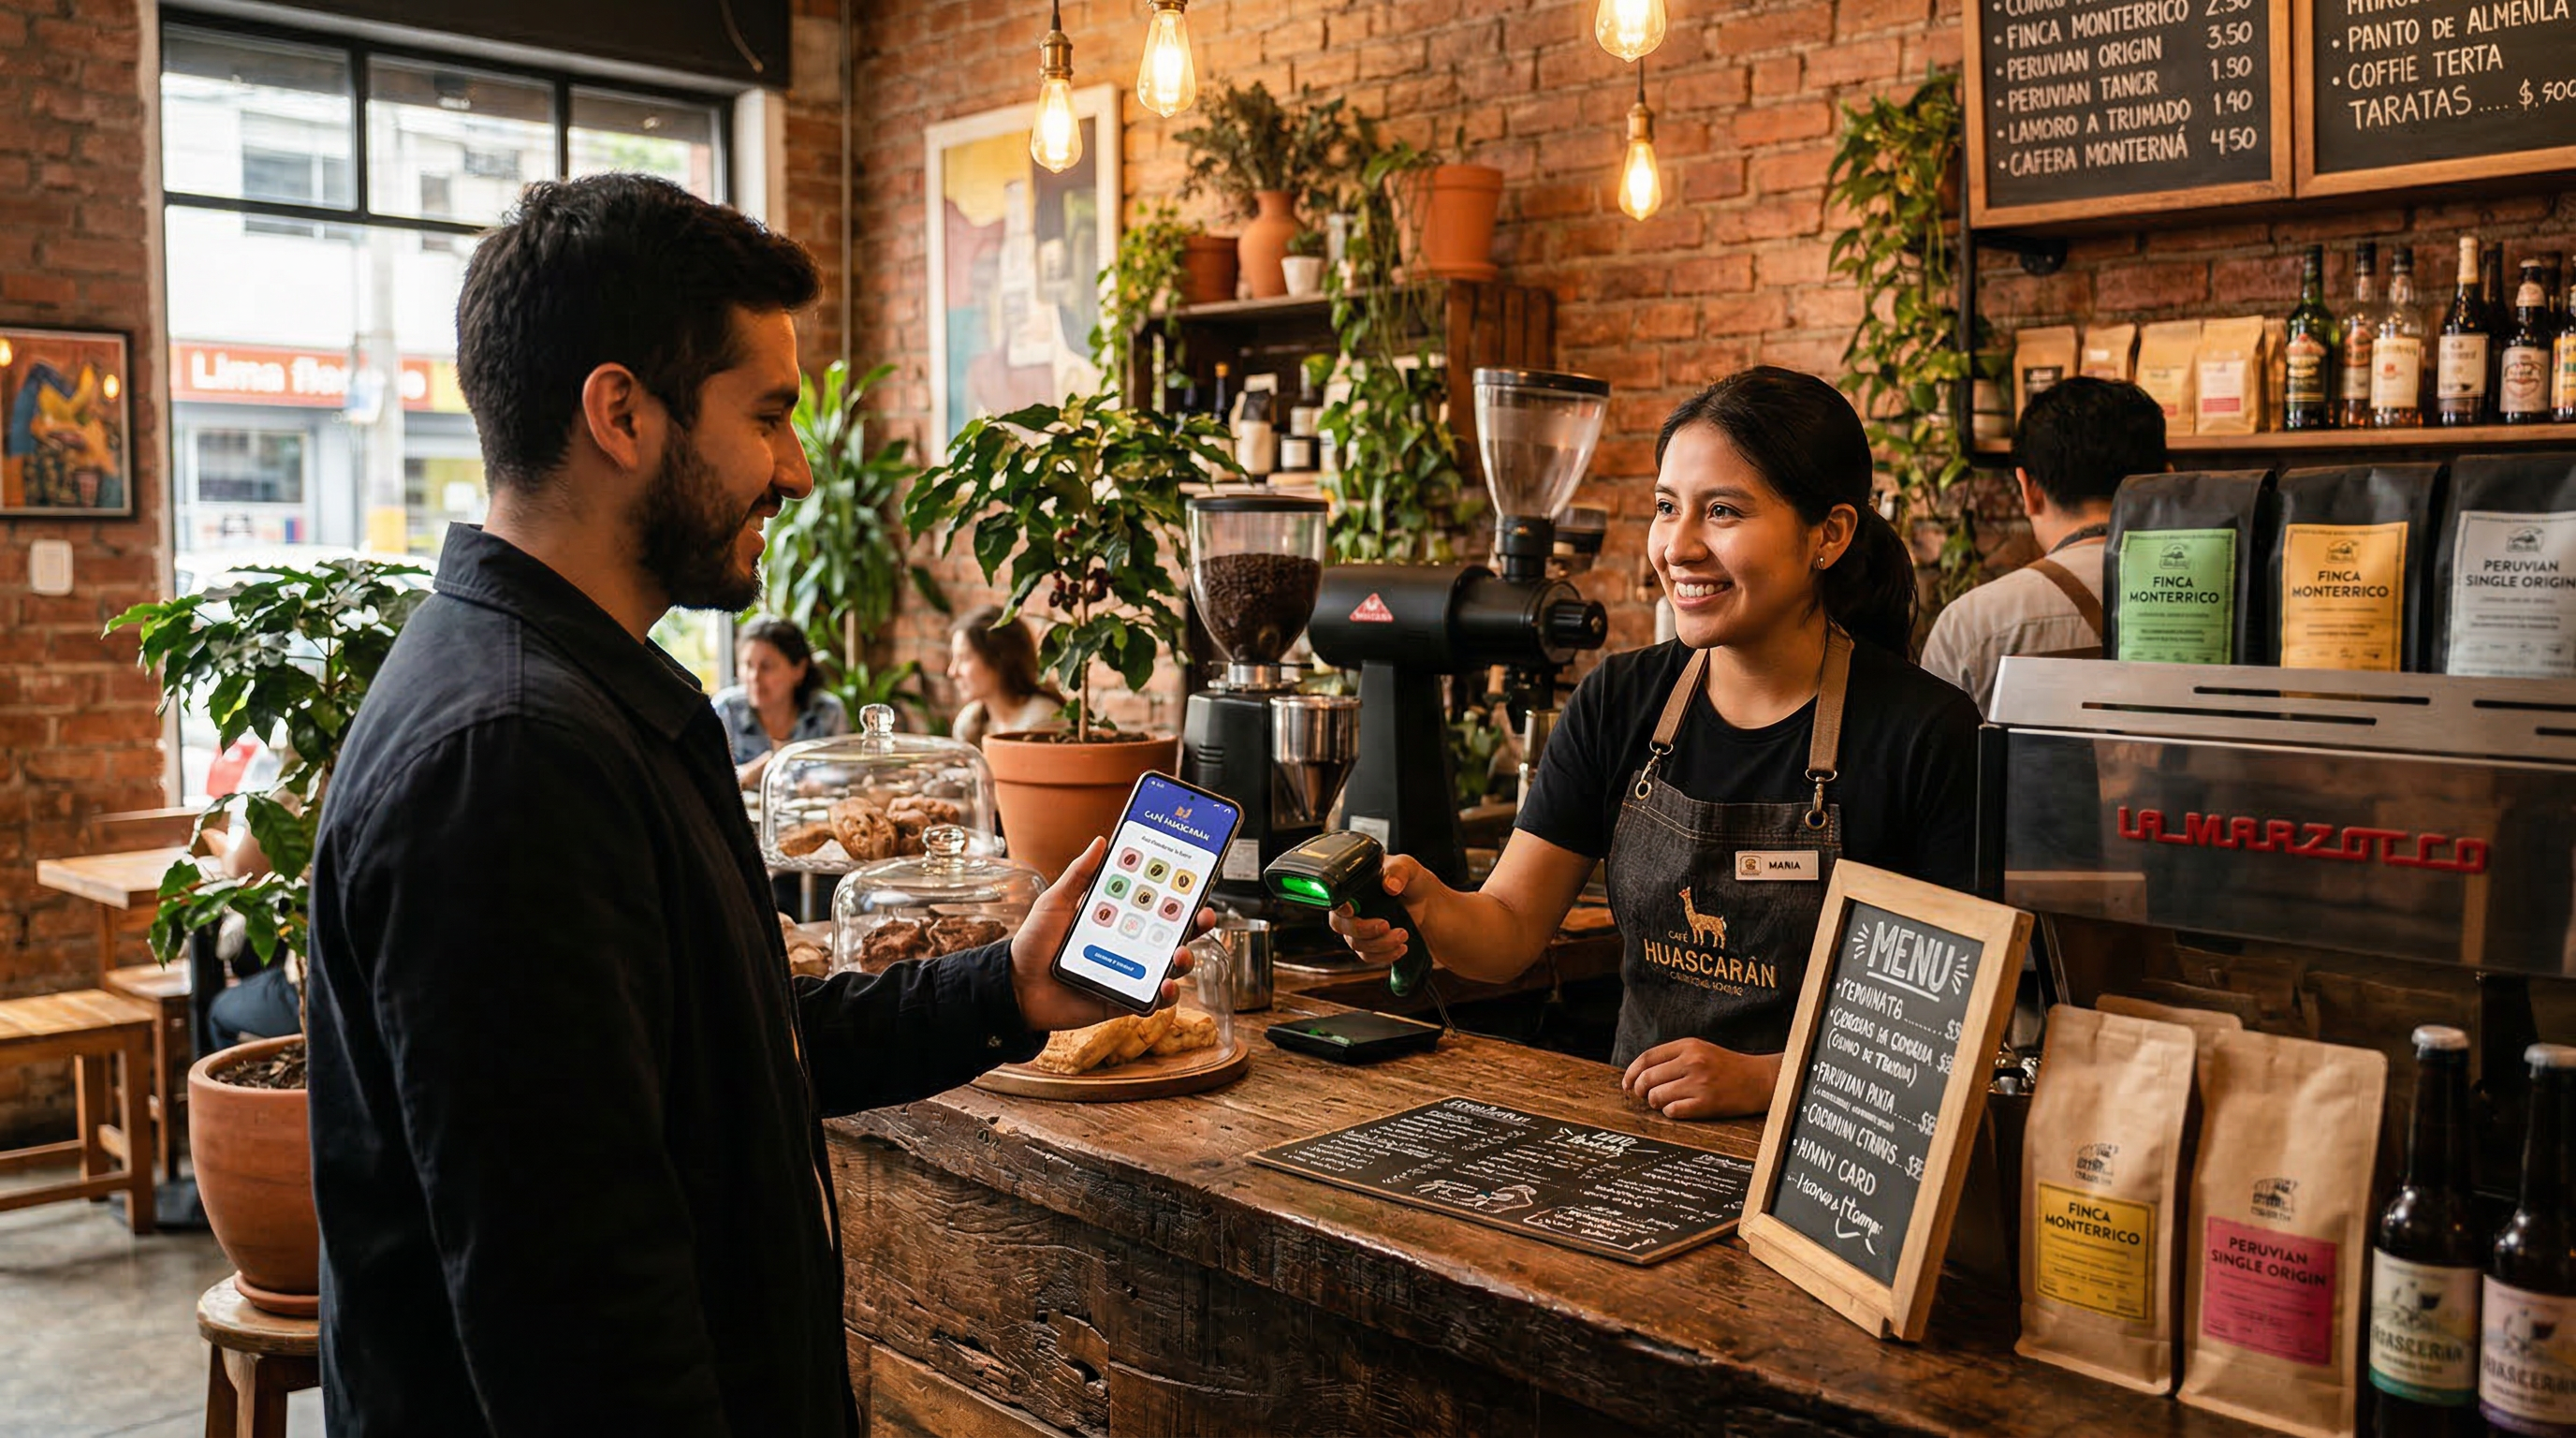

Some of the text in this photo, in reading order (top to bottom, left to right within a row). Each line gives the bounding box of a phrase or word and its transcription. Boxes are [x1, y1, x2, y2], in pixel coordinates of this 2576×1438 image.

[2007, 19, 2062, 51] FINCA
[2071, 0, 2189, 39] MONTERRICO
[2206, 21, 2253, 50] 3.50
[2348, 19, 2421, 52] PANTO
[2432, 17, 2455, 40] DE
[2007, 36, 2162, 82] PERUVIAN ORIGIN
[2433, 44, 2504, 78] TERTA
[2009, 81, 2091, 113] PERUVIAN
[2009, 97, 2192, 144] LAMORO A TRUMADO
[2010, 146, 2078, 177] CAFERA
[2318, 570, 2362, 582] FINCA
[2483, 560, 2559, 573] PERUVIAN
[2130, 591, 2219, 604] MONTERRICO
[2153, 576, 2194, 589] FINCA
[2292, 585, 2390, 599] MONTERRICO
[2466, 575, 2576, 590] SINGLE ORIGIN
[1866, 920, 1956, 993] MENU
[1837, 1159, 1877, 1196] CARD
[2069, 1202, 2112, 1224] FINCA
[2045, 1213, 2141, 1246] MONTERRICO
[2229, 1237, 2308, 1266] PERUVIAN
[2211, 1249, 2327, 1287] SINGLE ORIGIN
